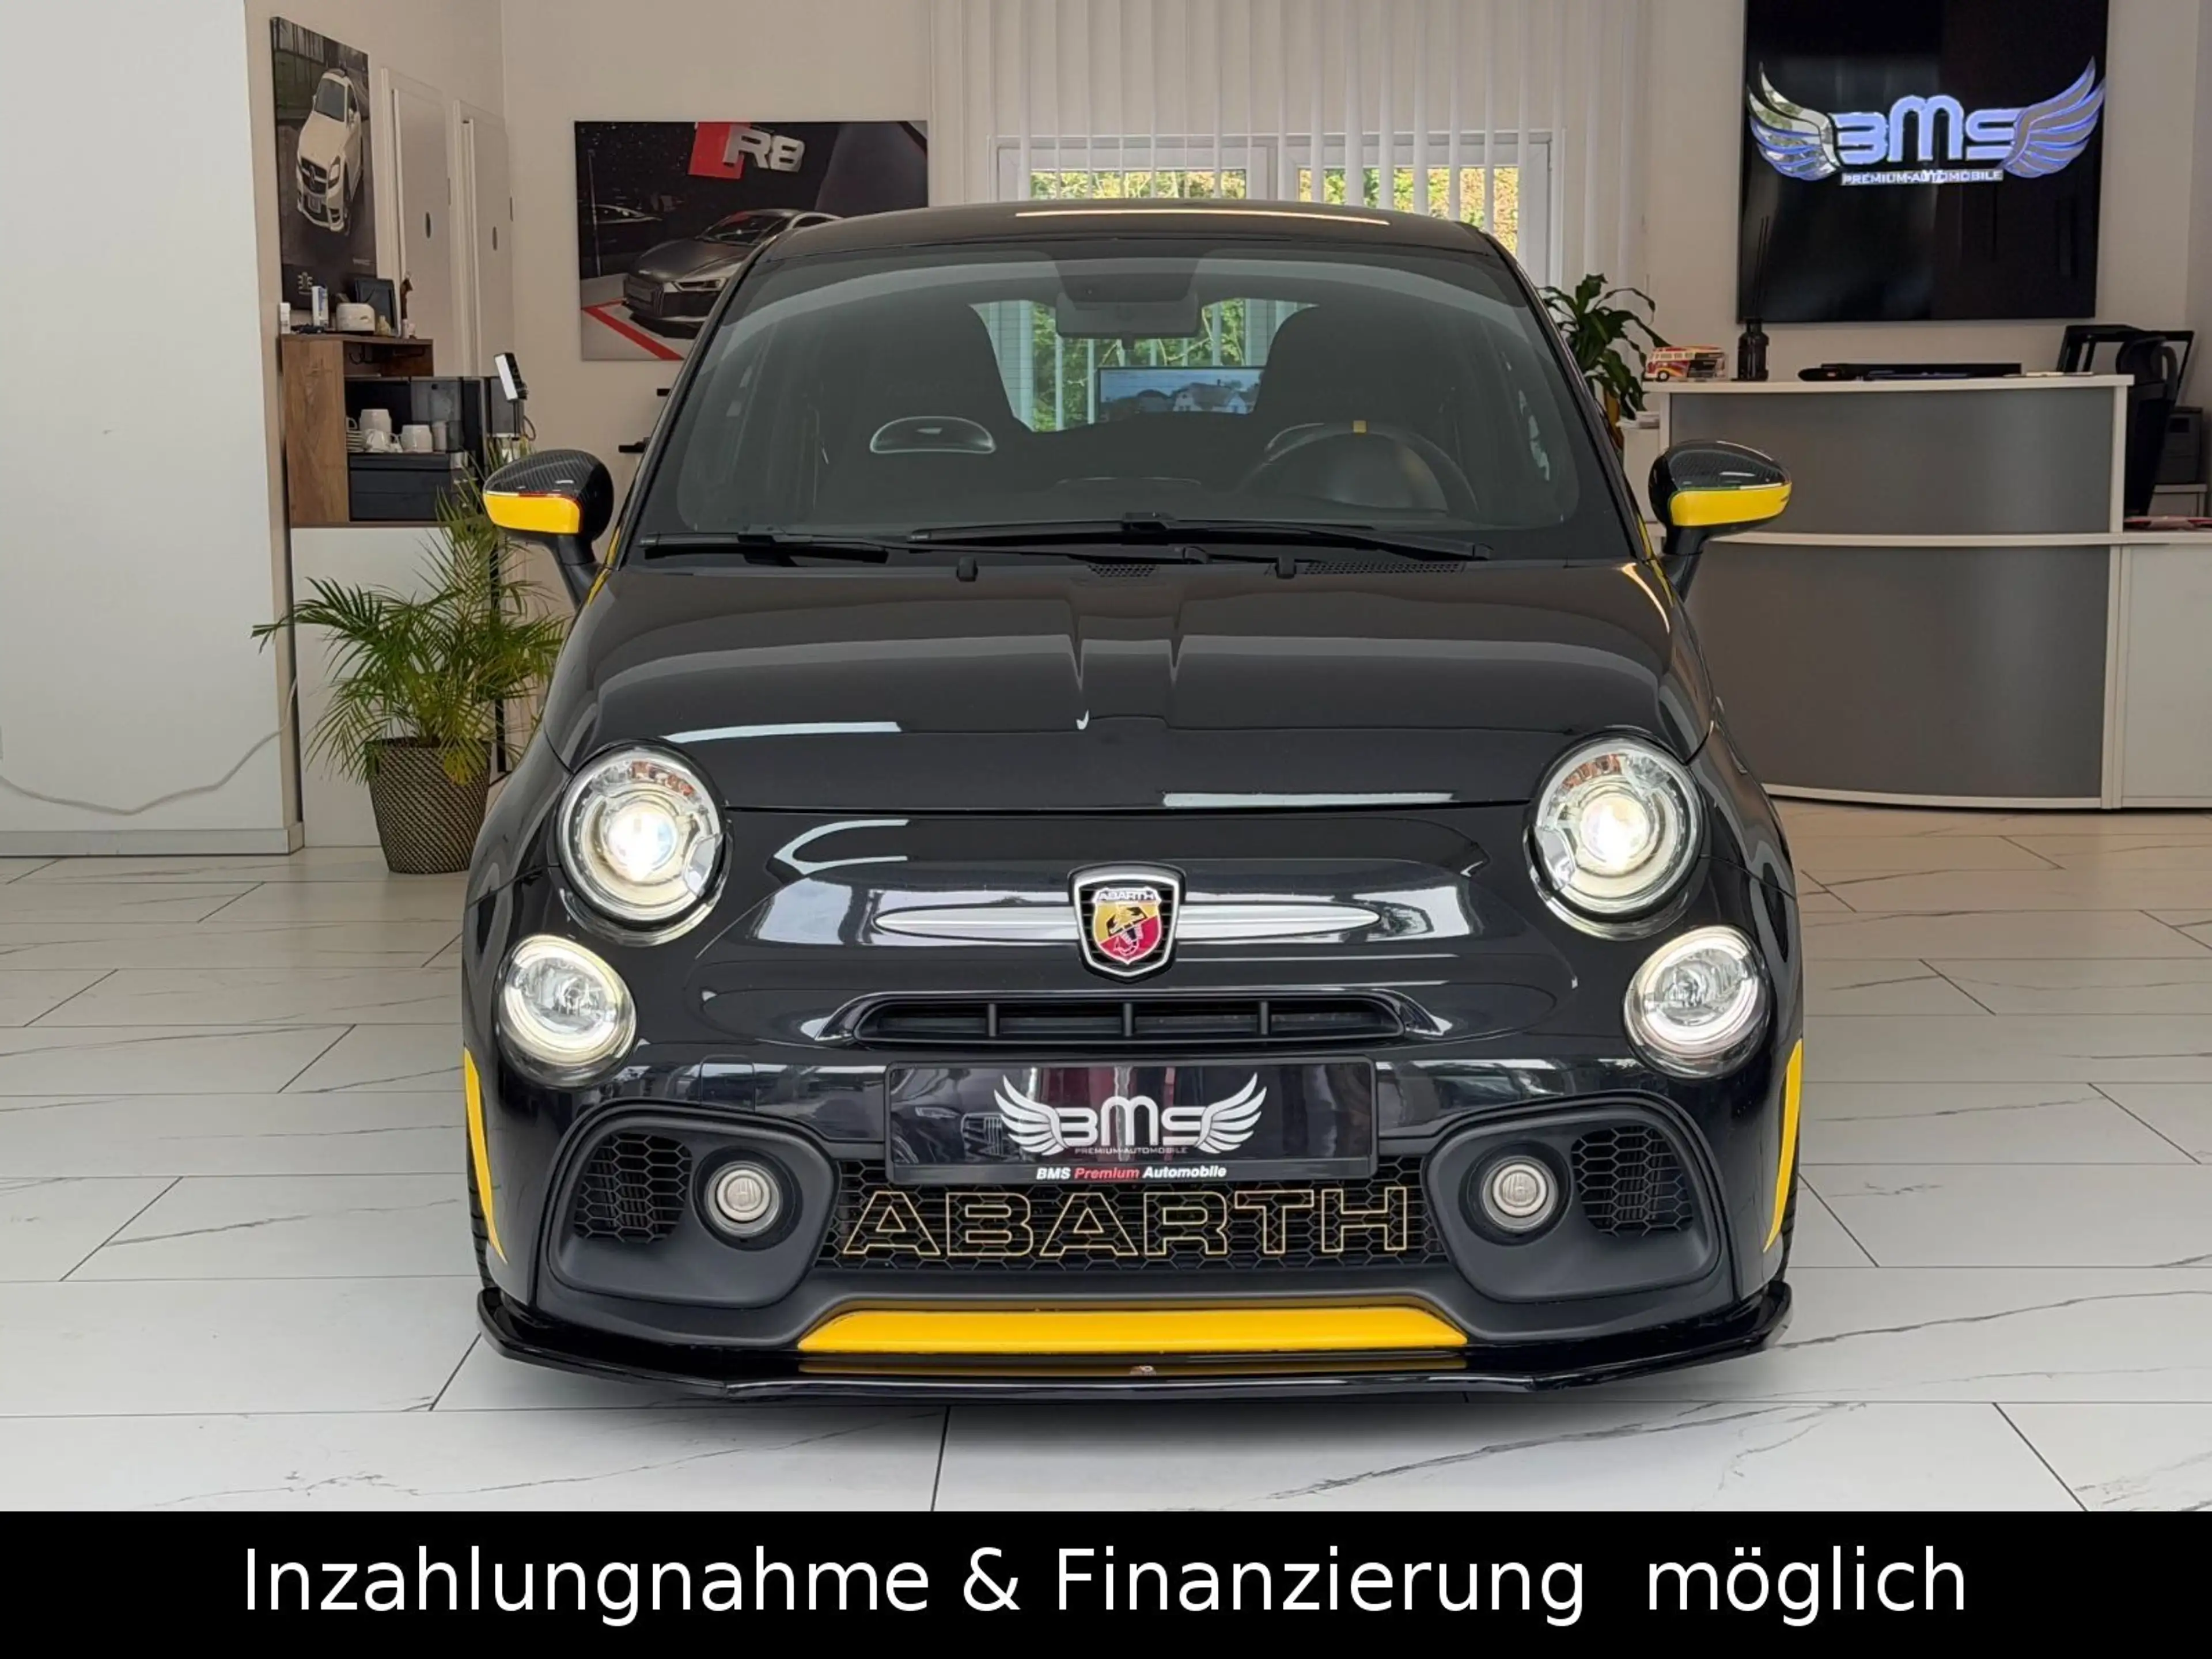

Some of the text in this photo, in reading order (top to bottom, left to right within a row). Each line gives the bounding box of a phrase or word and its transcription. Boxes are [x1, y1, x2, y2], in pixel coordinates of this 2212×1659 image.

[722, 124, 805, 173] R8
[1831, 94, 2022, 165] BMS
[1099, 891, 1155, 902] ABARTH
[1055, 1096, 1206, 1147] BMS
[1036, 1165, 1228, 1180] BMS Premium Automobile
[842, 1186, 1407, 1257] ABARTH
